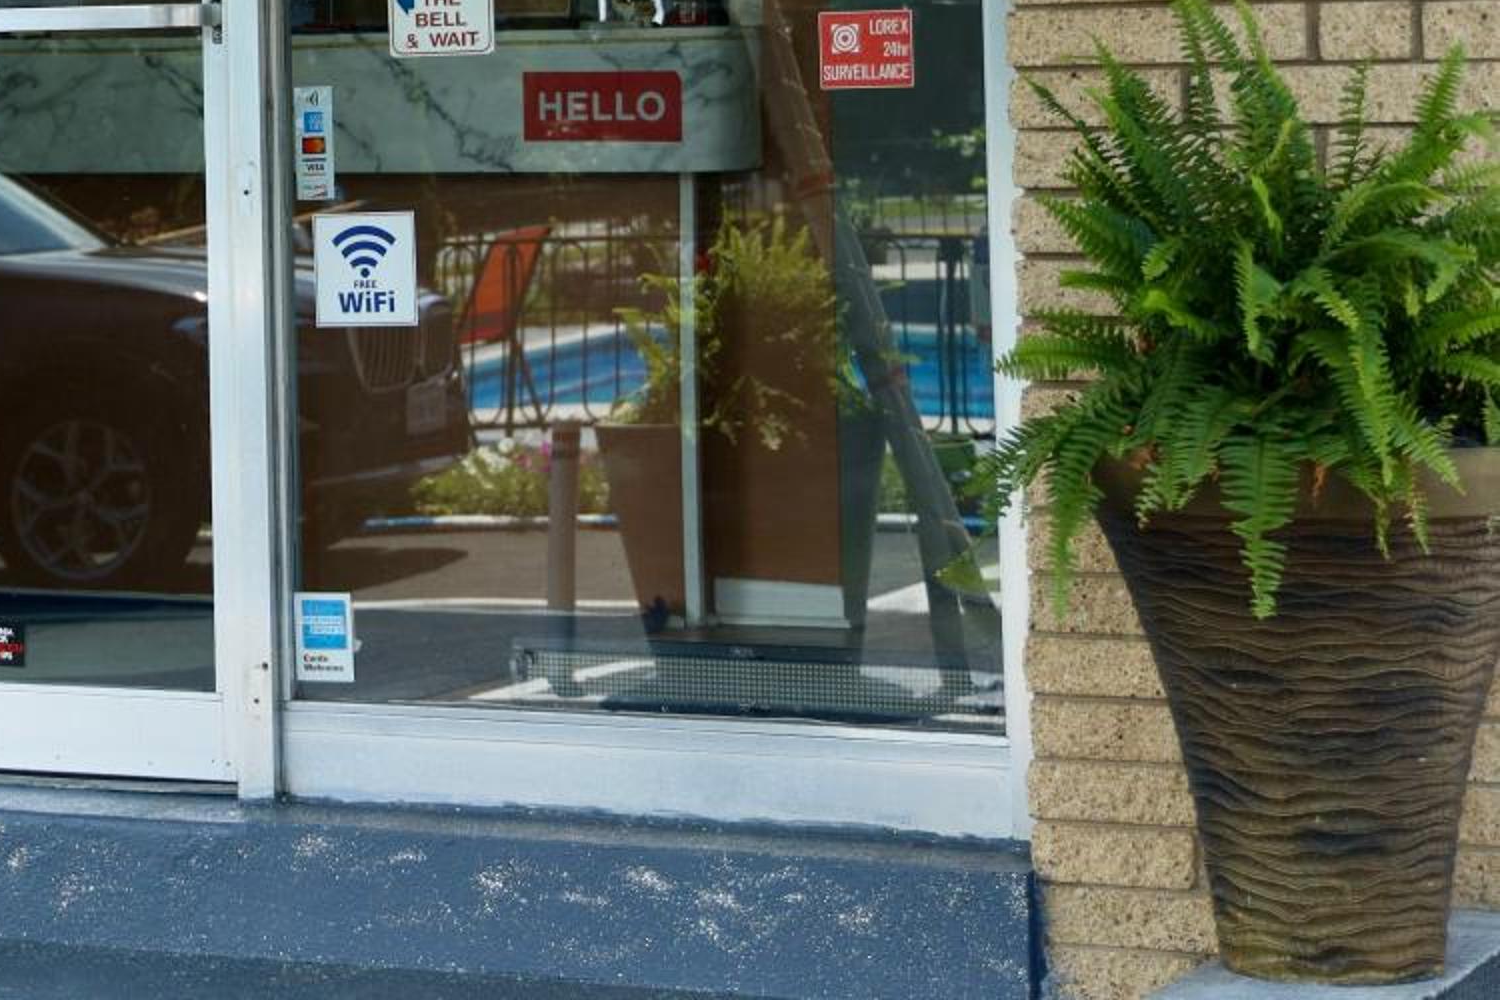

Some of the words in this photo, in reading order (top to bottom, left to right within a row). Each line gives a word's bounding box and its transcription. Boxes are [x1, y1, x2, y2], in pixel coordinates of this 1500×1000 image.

[415, 12, 467, 27] BELL
[869, 18, 909, 35] LOREX
[407, 34, 418, 48] &
[429, 31, 479, 47] WAIT
[823, 63, 911, 81] SURVEILLANCE
[538, 91, 666, 121] HELLO
[354, 280, 377, 289] FREE
[338, 291, 395, 313] WiFi
